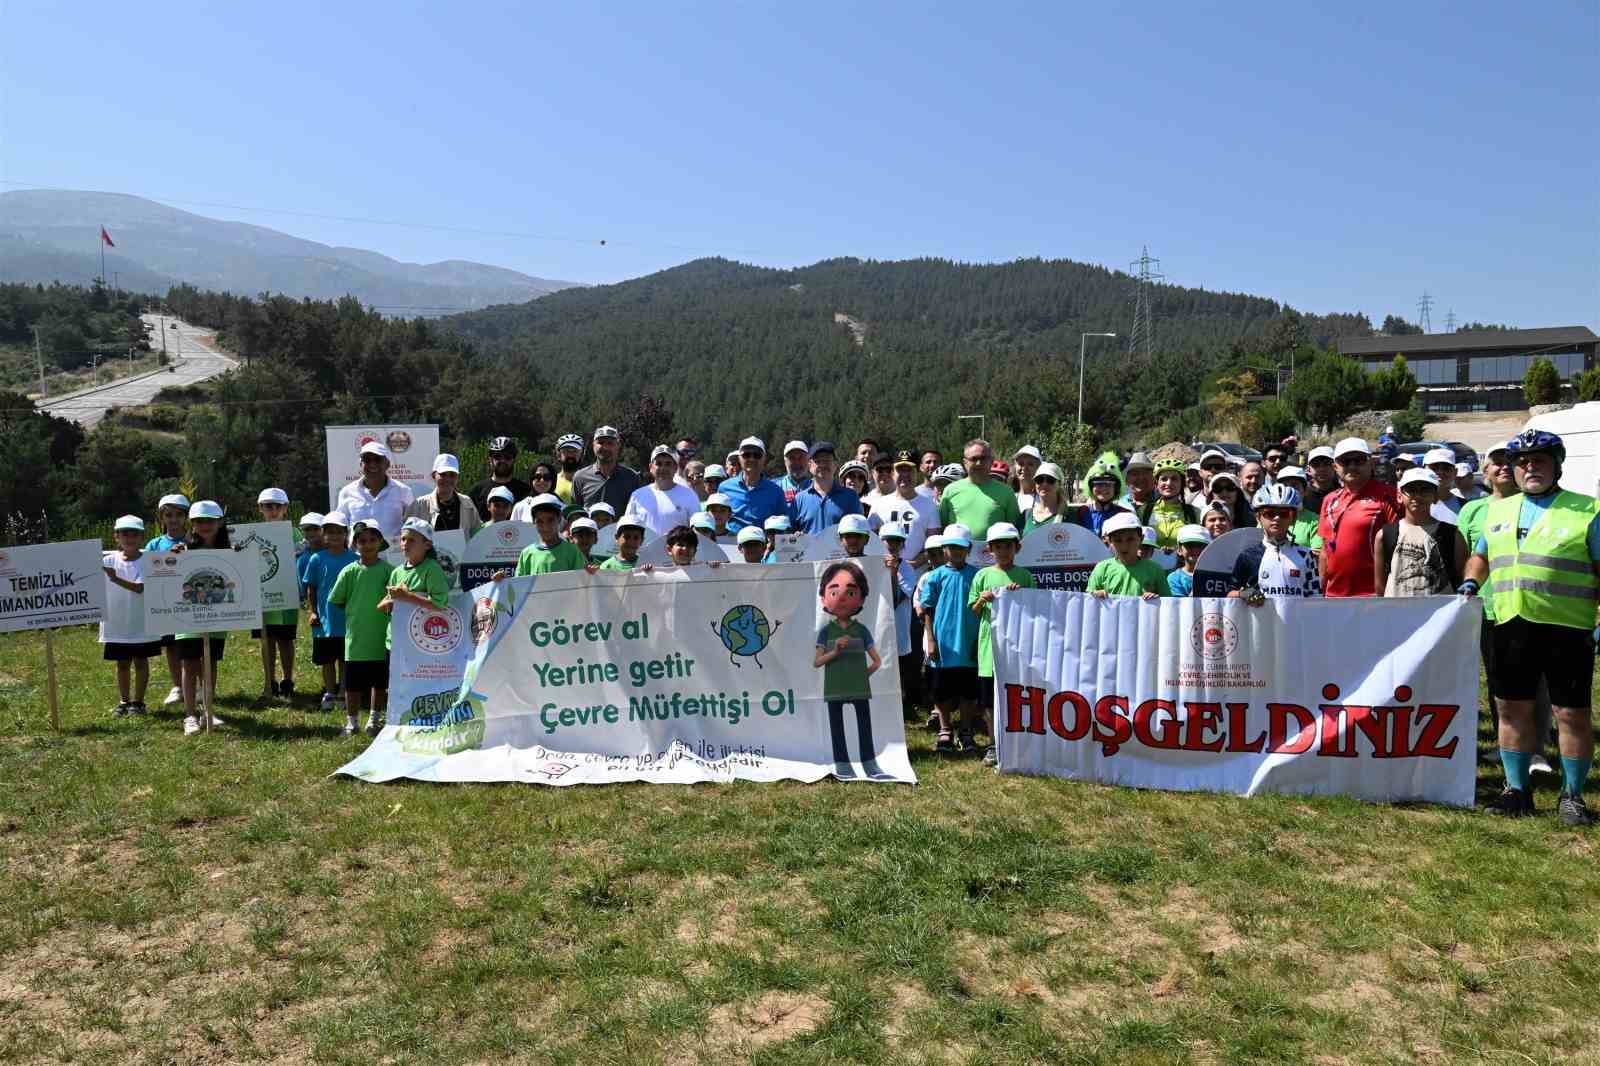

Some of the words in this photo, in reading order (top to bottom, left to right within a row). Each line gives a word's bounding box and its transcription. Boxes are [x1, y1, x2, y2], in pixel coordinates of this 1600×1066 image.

[9, 569, 75, 592] TEMİZLİK
[1032, 572, 1061, 584] EVRE
[1064, 571, 1093, 583] DOS
[1205, 579, 1230, 595] ÇEV
[529, 619, 613, 647] Görev
[622, 613, 649, 640] al
[533, 658, 619, 688] Yerine
[629, 652, 695, 688] getir
[540, 702, 619, 734] Çevre
[628, 691, 750, 725] Müfettişi
[762, 689, 796, 716] Ol
[1004, 683, 1460, 759] HOŞGELDİNİZ
[698, 739, 715, 759] ile
